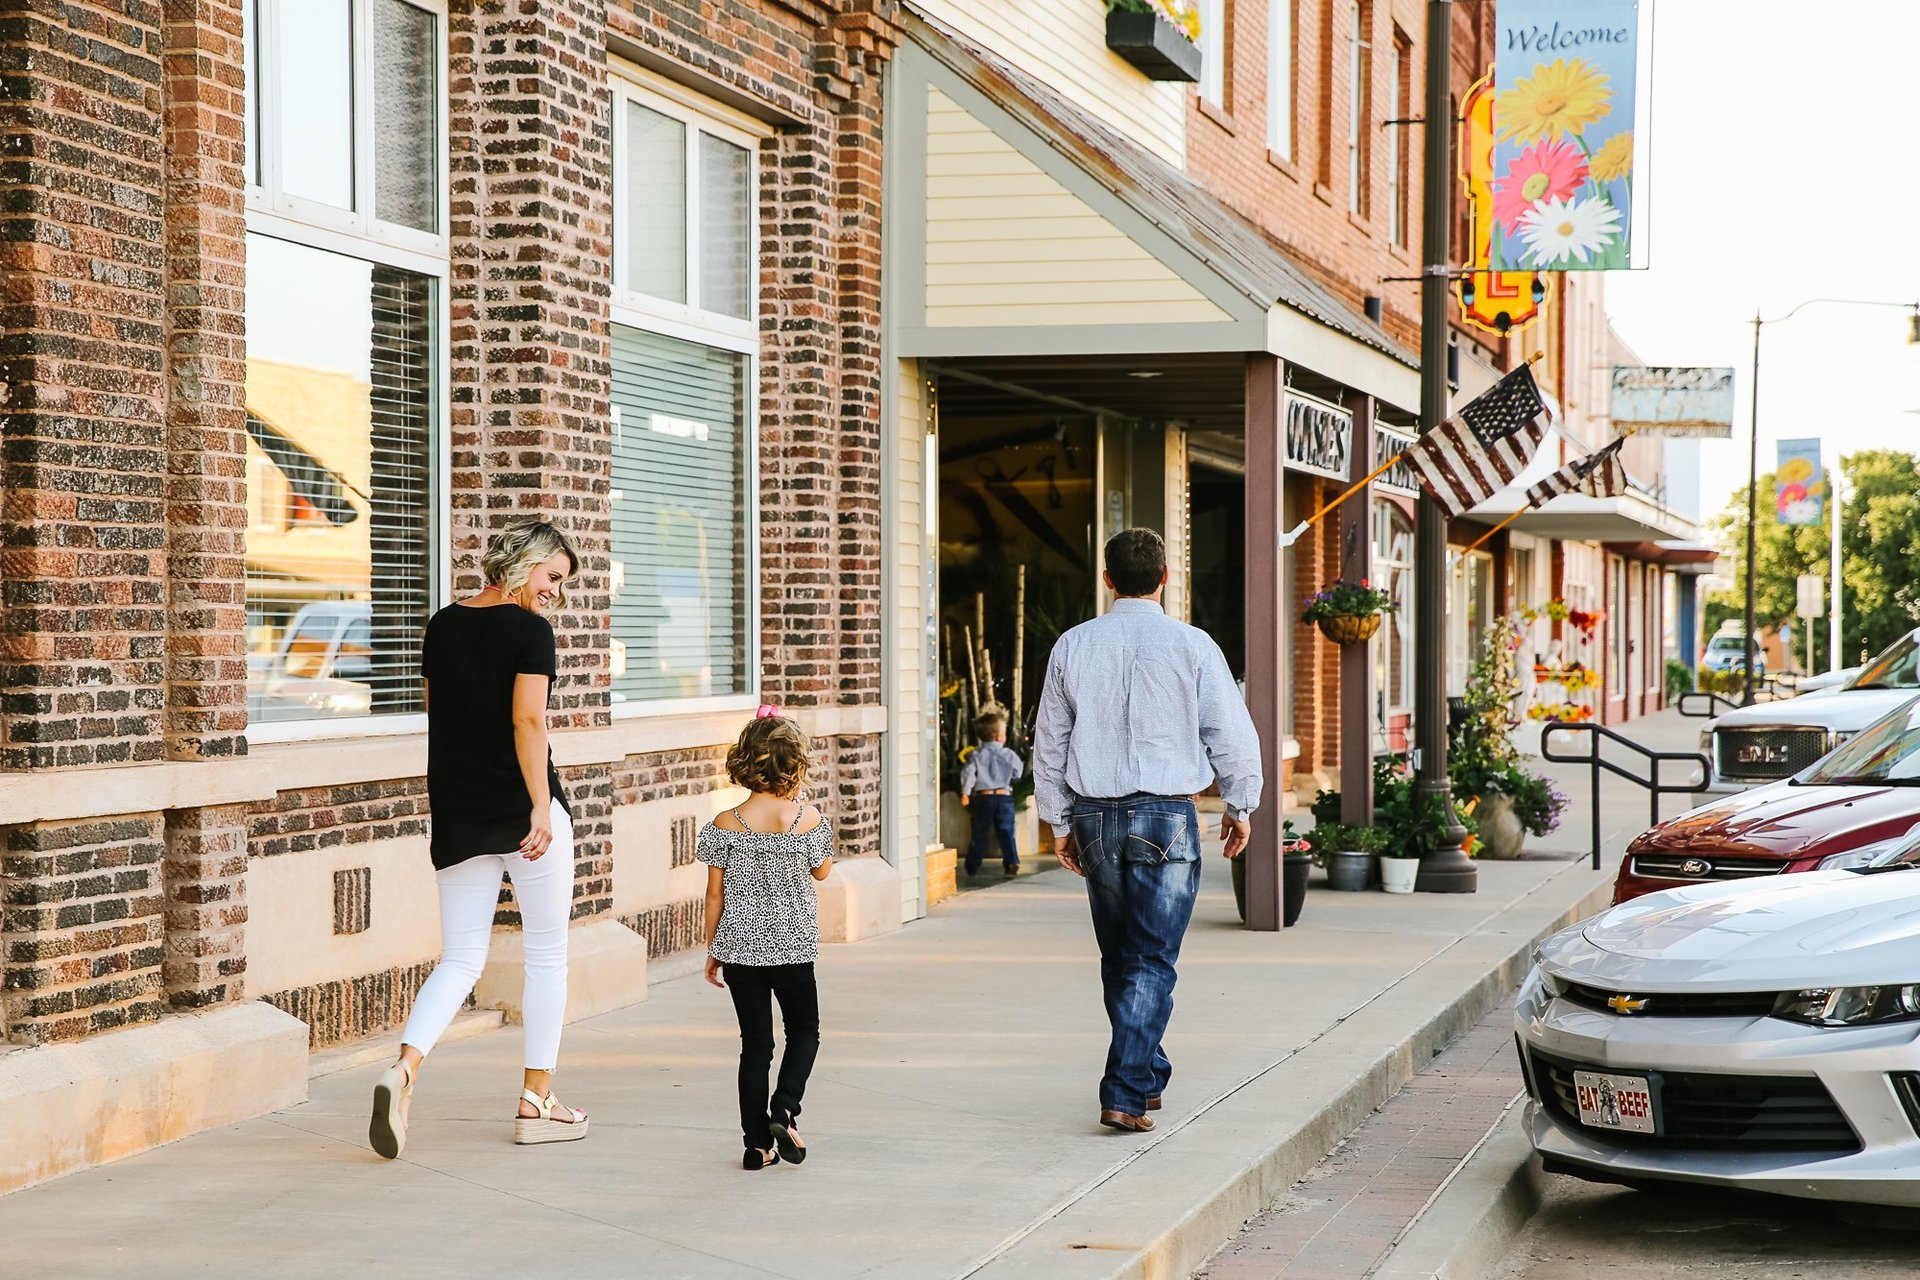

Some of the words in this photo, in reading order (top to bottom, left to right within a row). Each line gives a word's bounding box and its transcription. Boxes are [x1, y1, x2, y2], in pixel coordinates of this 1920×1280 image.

[1507, 21, 1628, 51] Welcome
[1683, 860, 1703, 872] Ford
[1578, 1086, 1599, 1113] EAT
[1617, 1090, 1649, 1118] BEEF
